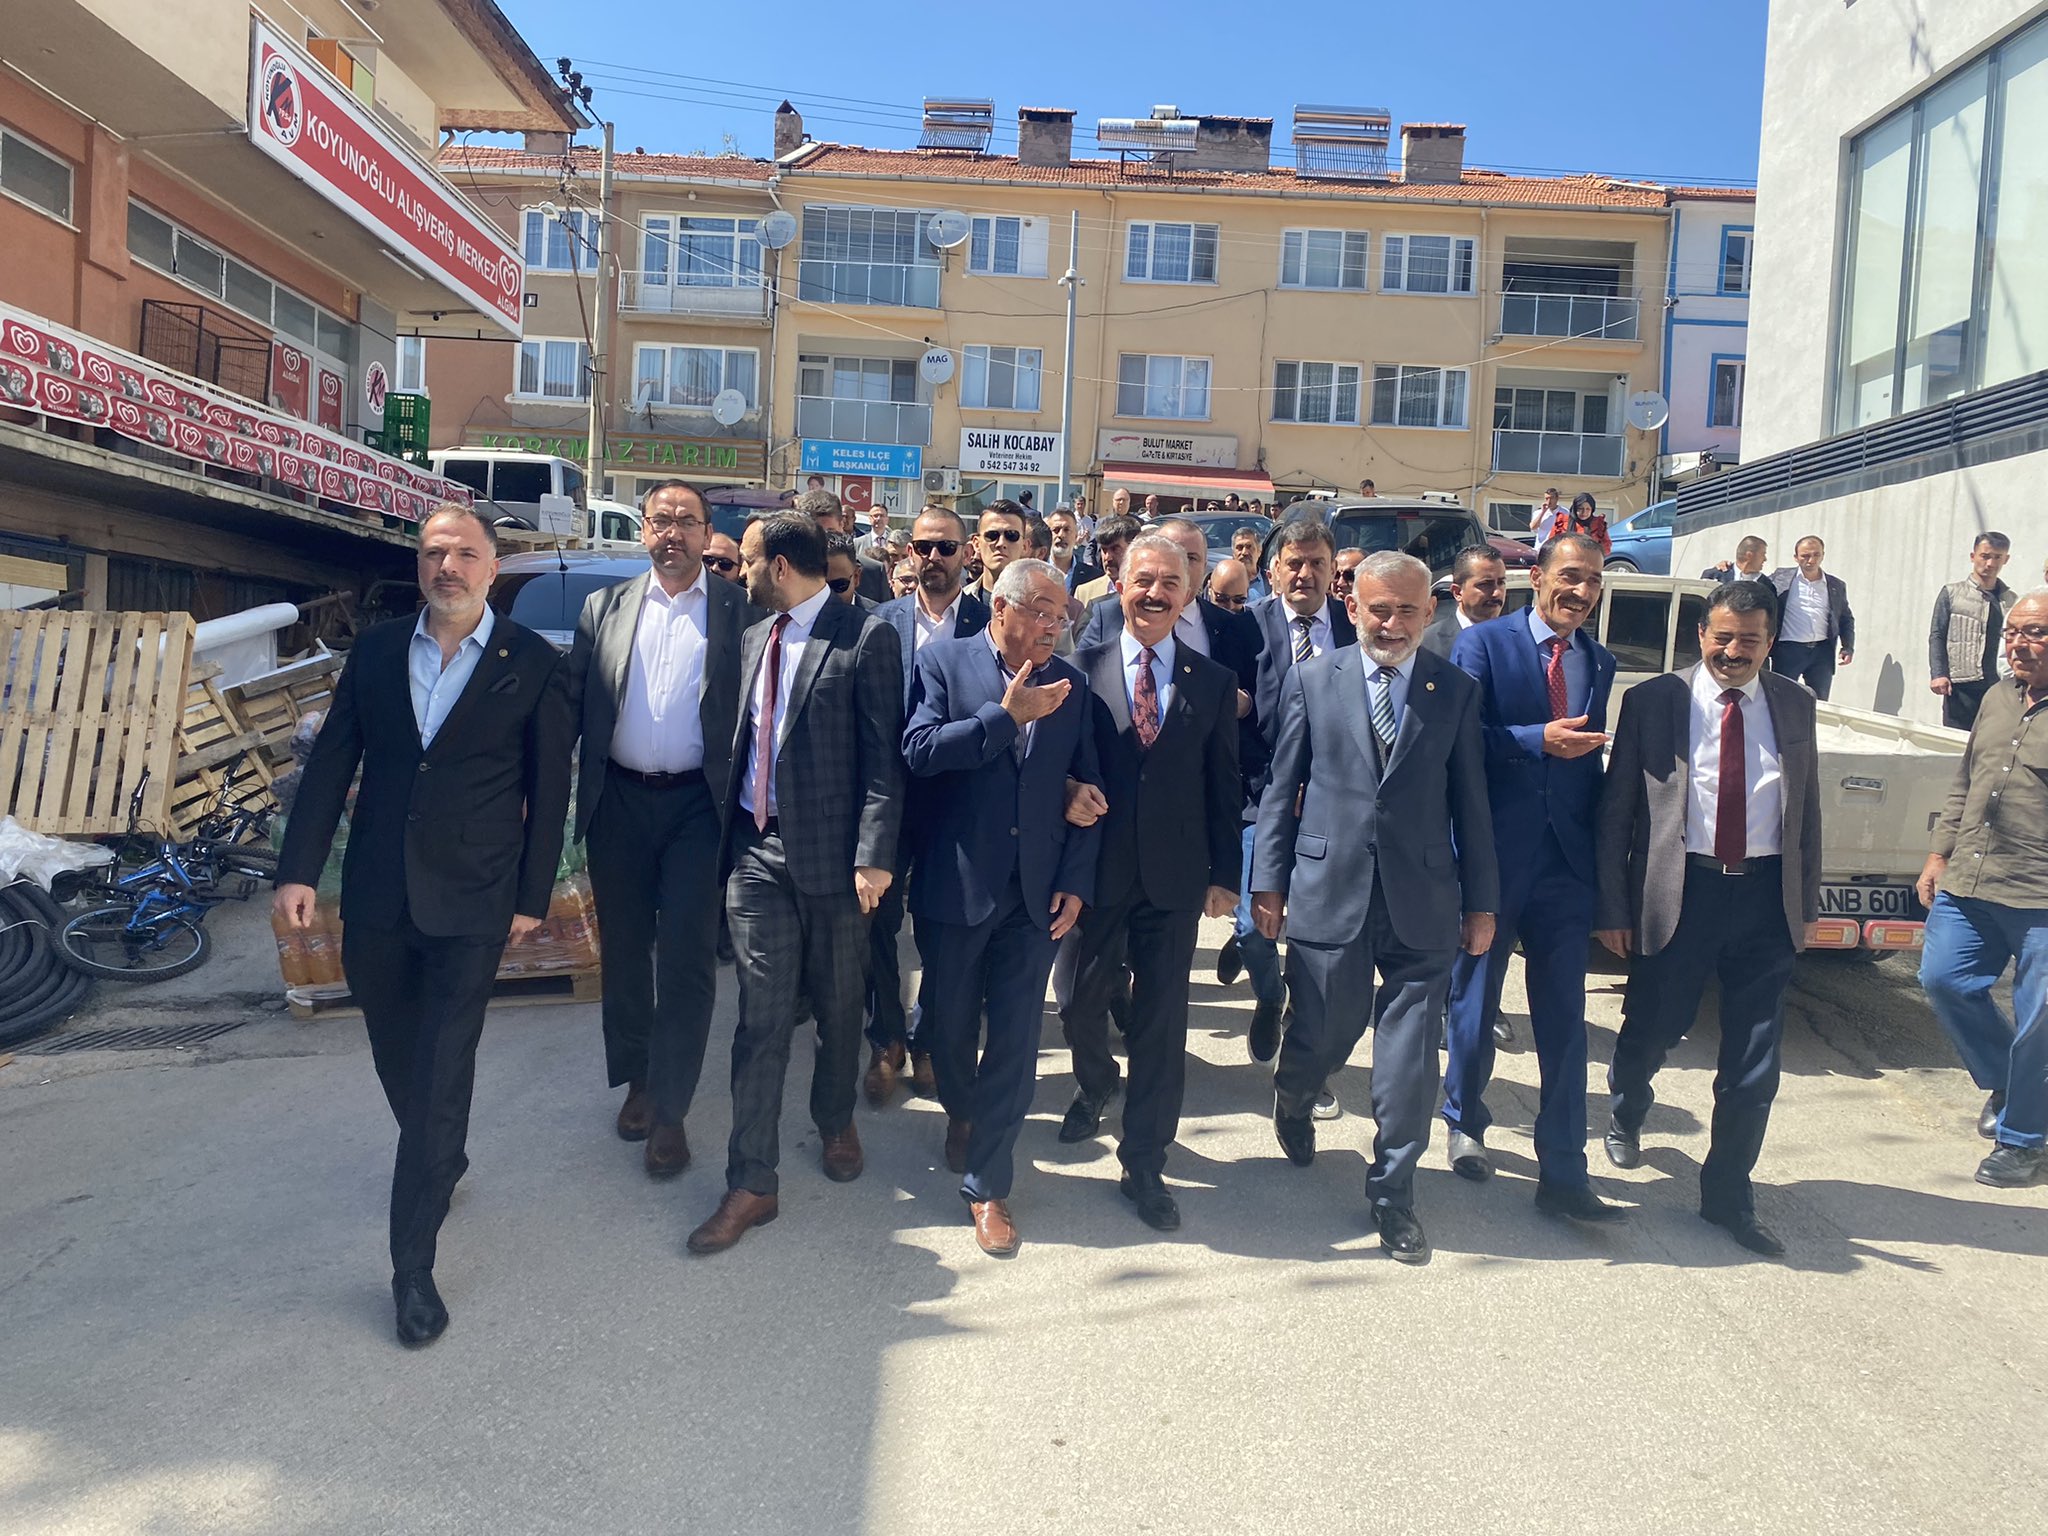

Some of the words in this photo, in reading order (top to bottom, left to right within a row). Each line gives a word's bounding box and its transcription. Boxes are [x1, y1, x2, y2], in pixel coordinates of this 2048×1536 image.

[281, 113, 298, 139] AVM
[306, 109, 395, 204] KOYUNOĞLU
[396, 188, 455, 257] ALIŞVERİŞ
[456, 236, 499, 288] MERKEZİ
[496, 294, 519, 321] ALGIDA
[926, 354, 948, 364] MAG
[1004, 434, 1056, 452] KOCABAY
[1142, 437, 1165, 448] BULUT
[1165, 438, 1193, 450] MARKET
[646, 442, 738, 469] TARIM
[832, 448, 865, 459] KELES
[867, 449, 891, 461] İLÇE
[1015, 452, 1032, 460] Hekim
[832, 460, 890, 471] BAŞKANLIĞI
[980, 459, 986, 469] 0
[987, 460, 1001, 470] 542
[1003, 461, 1017, 471] 547
[1019, 462, 1028, 471] 34
[1030, 463, 1040, 472] 92
[1869, 889, 1909, 914] 601
